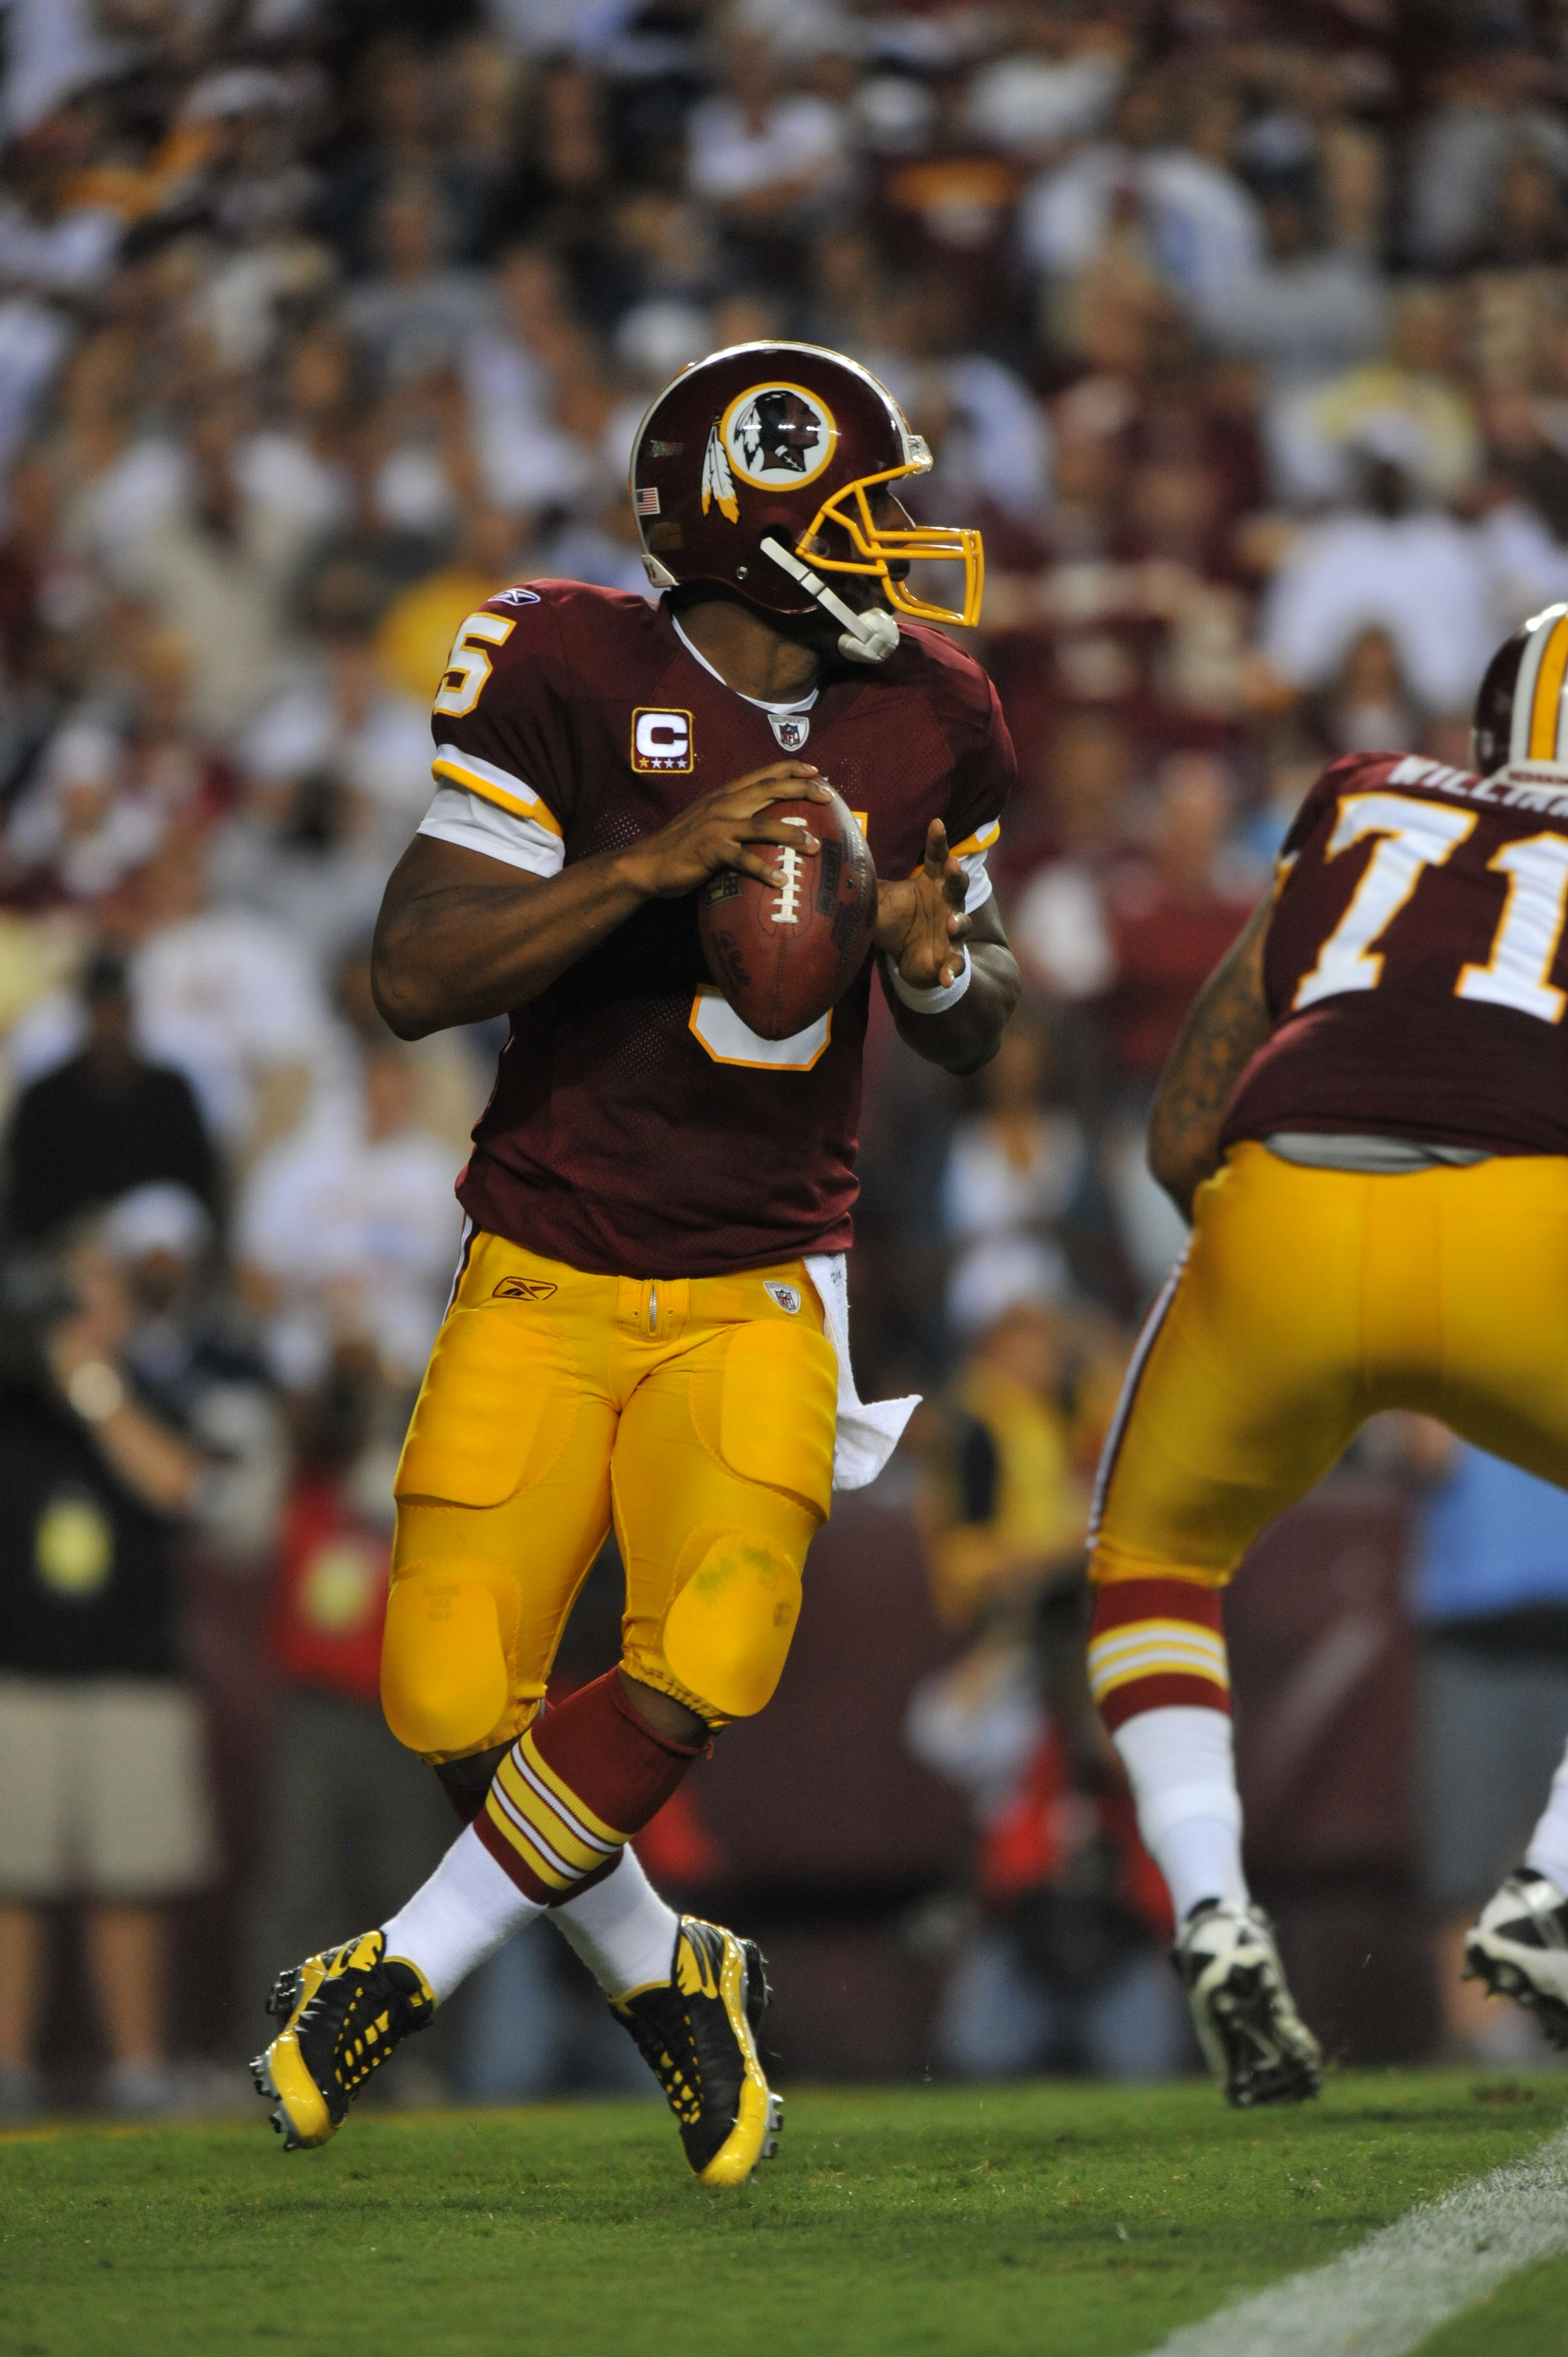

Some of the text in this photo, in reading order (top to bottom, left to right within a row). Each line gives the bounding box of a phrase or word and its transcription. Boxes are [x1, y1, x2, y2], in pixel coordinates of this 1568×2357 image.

[433, 611, 517, 718] 5
[636, 713, 688, 758] C
[781, 732, 800, 745] NFL
[1292, 791, 1568, 1025] 71
[778, 1297, 796, 1309] NFL
